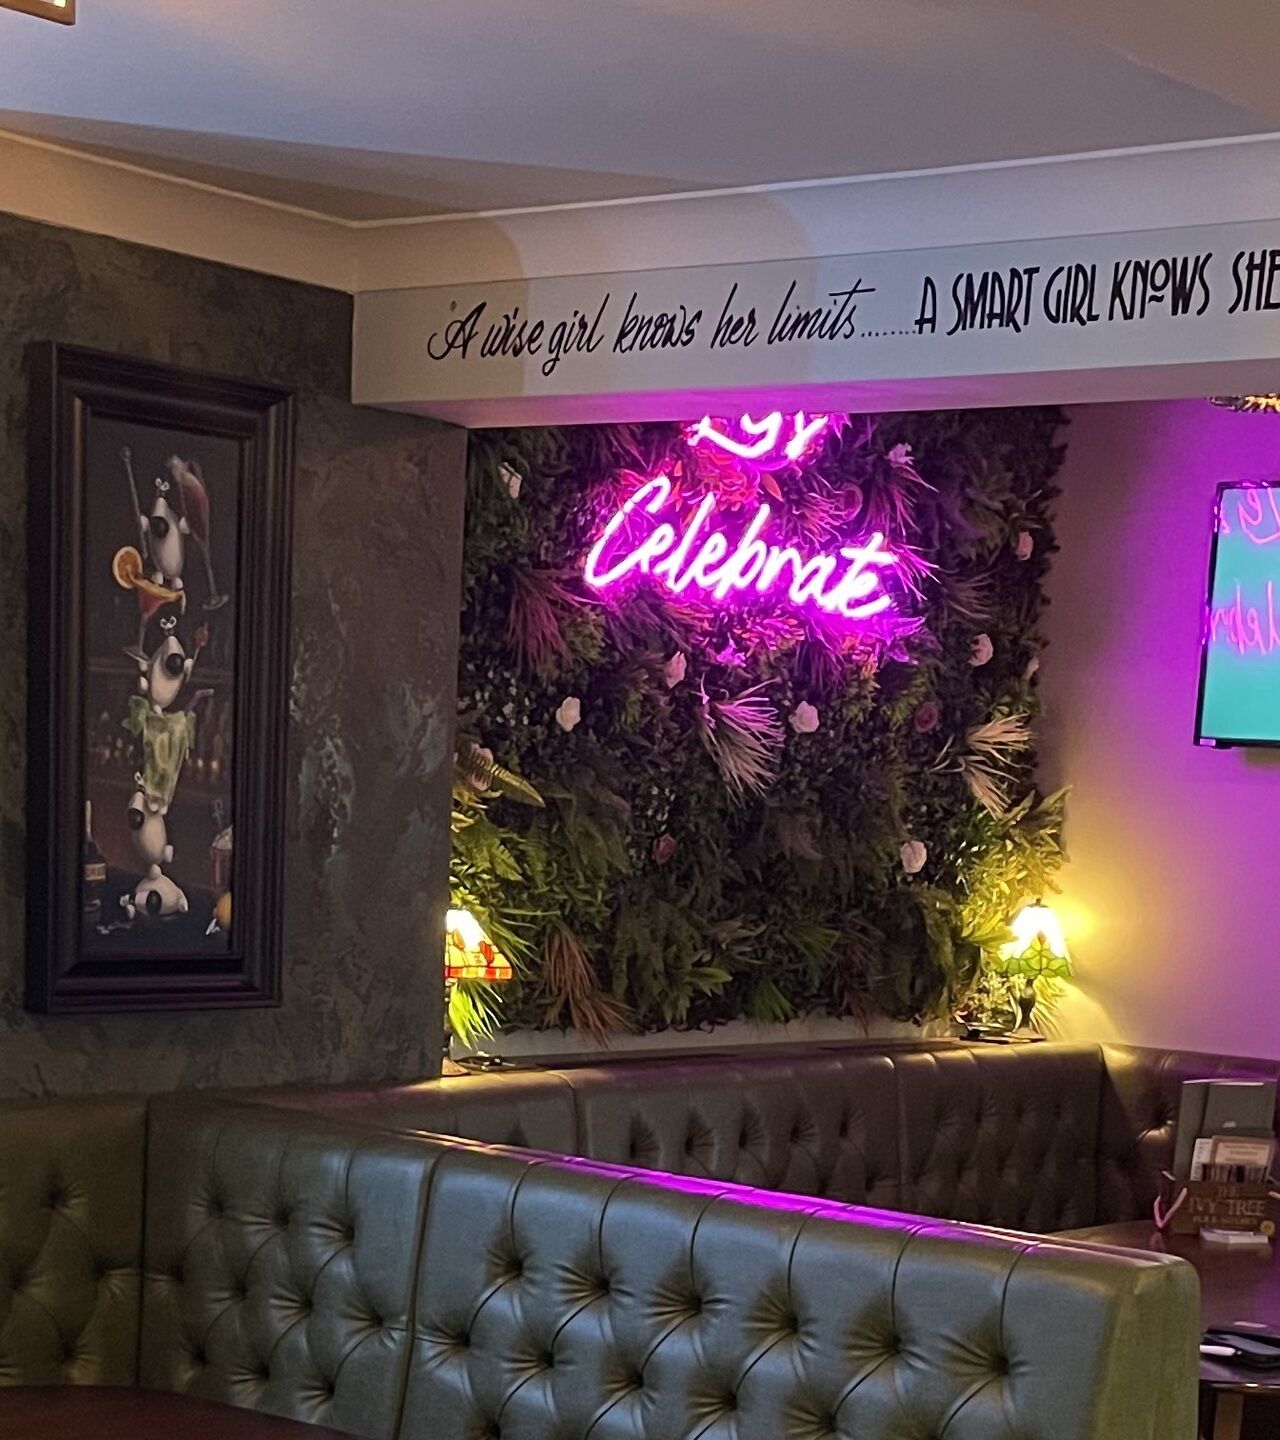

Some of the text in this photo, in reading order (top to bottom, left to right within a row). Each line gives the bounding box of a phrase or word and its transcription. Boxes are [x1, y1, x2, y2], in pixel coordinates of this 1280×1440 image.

[480, 305, 546, 359] wise
[541, 292, 610, 377] girl
[613, 292, 703, 356] knows
[710, 283, 757, 349] her
[914, 275, 938, 335] A
[946, 265, 1040, 336] SMART
[1043, 263, 1101, 328] GIRL
[1108, 252, 1214, 322] KNOWS
[584, 472, 900, 619] Celebrate
